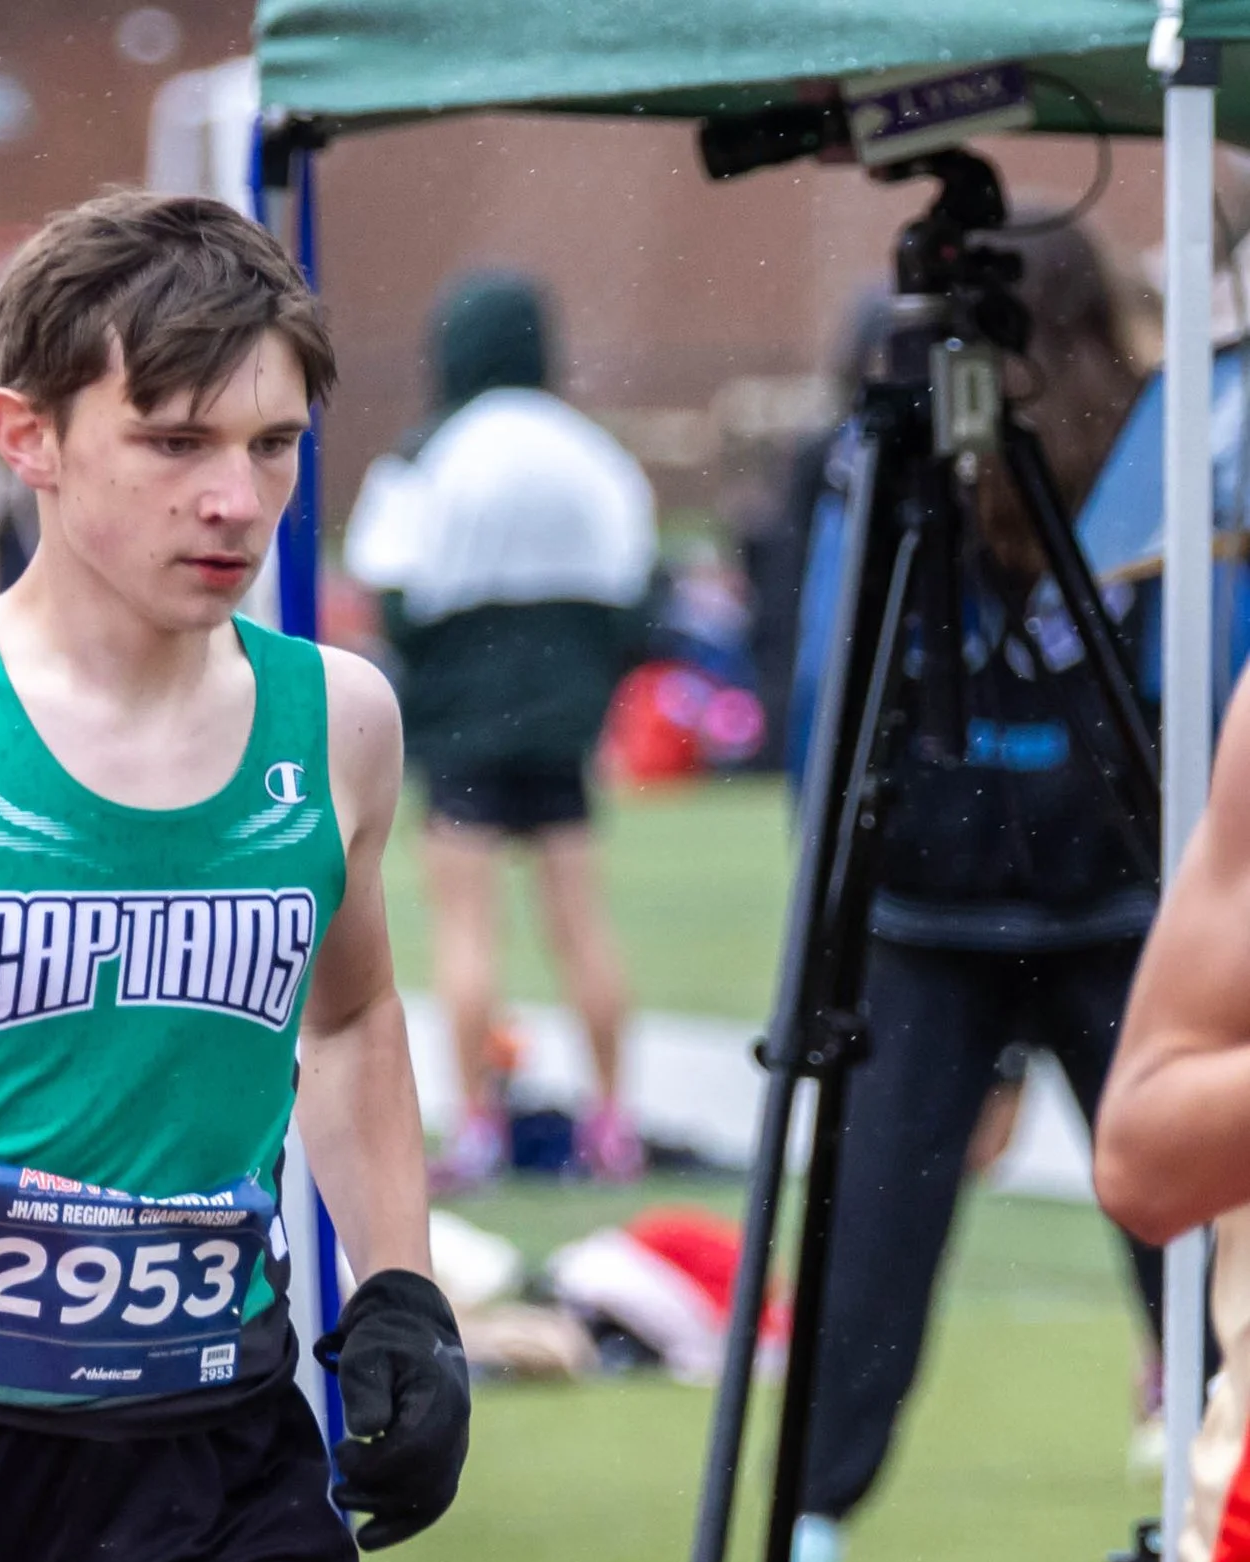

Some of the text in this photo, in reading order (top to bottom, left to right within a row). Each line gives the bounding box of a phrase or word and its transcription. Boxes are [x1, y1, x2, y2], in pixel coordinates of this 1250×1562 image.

[6, 1200, 248, 1228] JH/MS REGIONAL CHAMPIONSHIP
[199, 1364, 234, 1383] 2953
